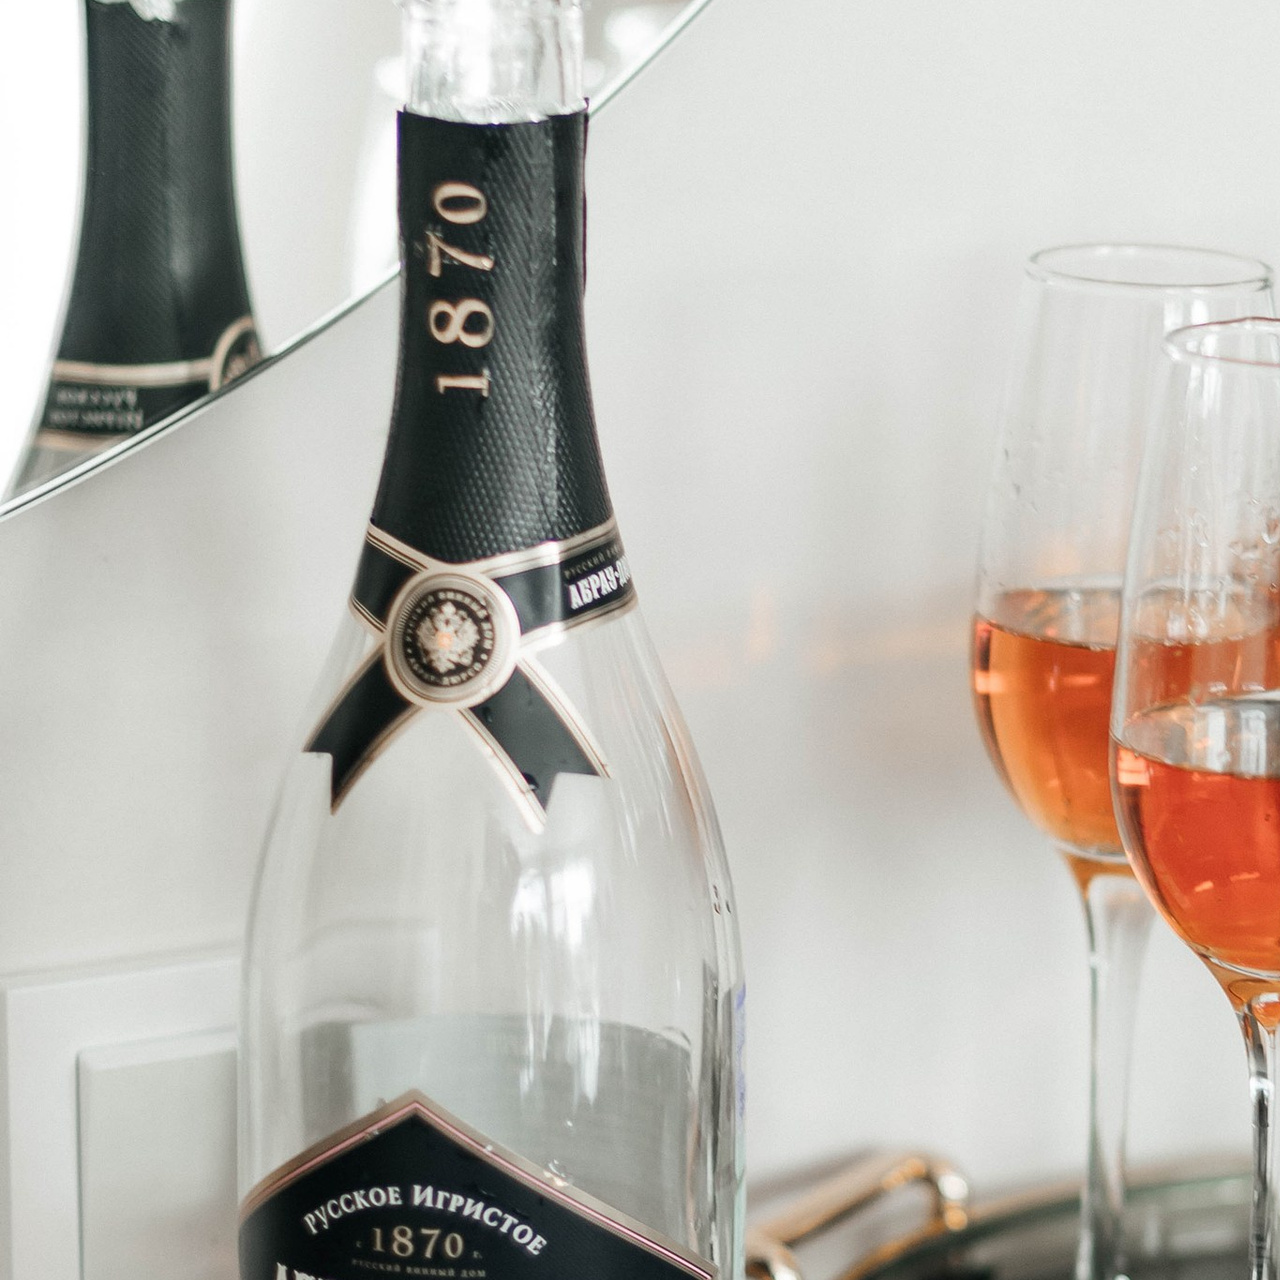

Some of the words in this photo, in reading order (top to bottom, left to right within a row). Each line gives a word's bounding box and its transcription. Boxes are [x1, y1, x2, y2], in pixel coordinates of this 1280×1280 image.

[431, 182, 494, 398] 1870
[303, 1186, 402, 1235] РУССКОЕ
[413, 1184, 547, 1256] ИГРИСТОЕ
[372, 1225, 464, 1258] 1870
